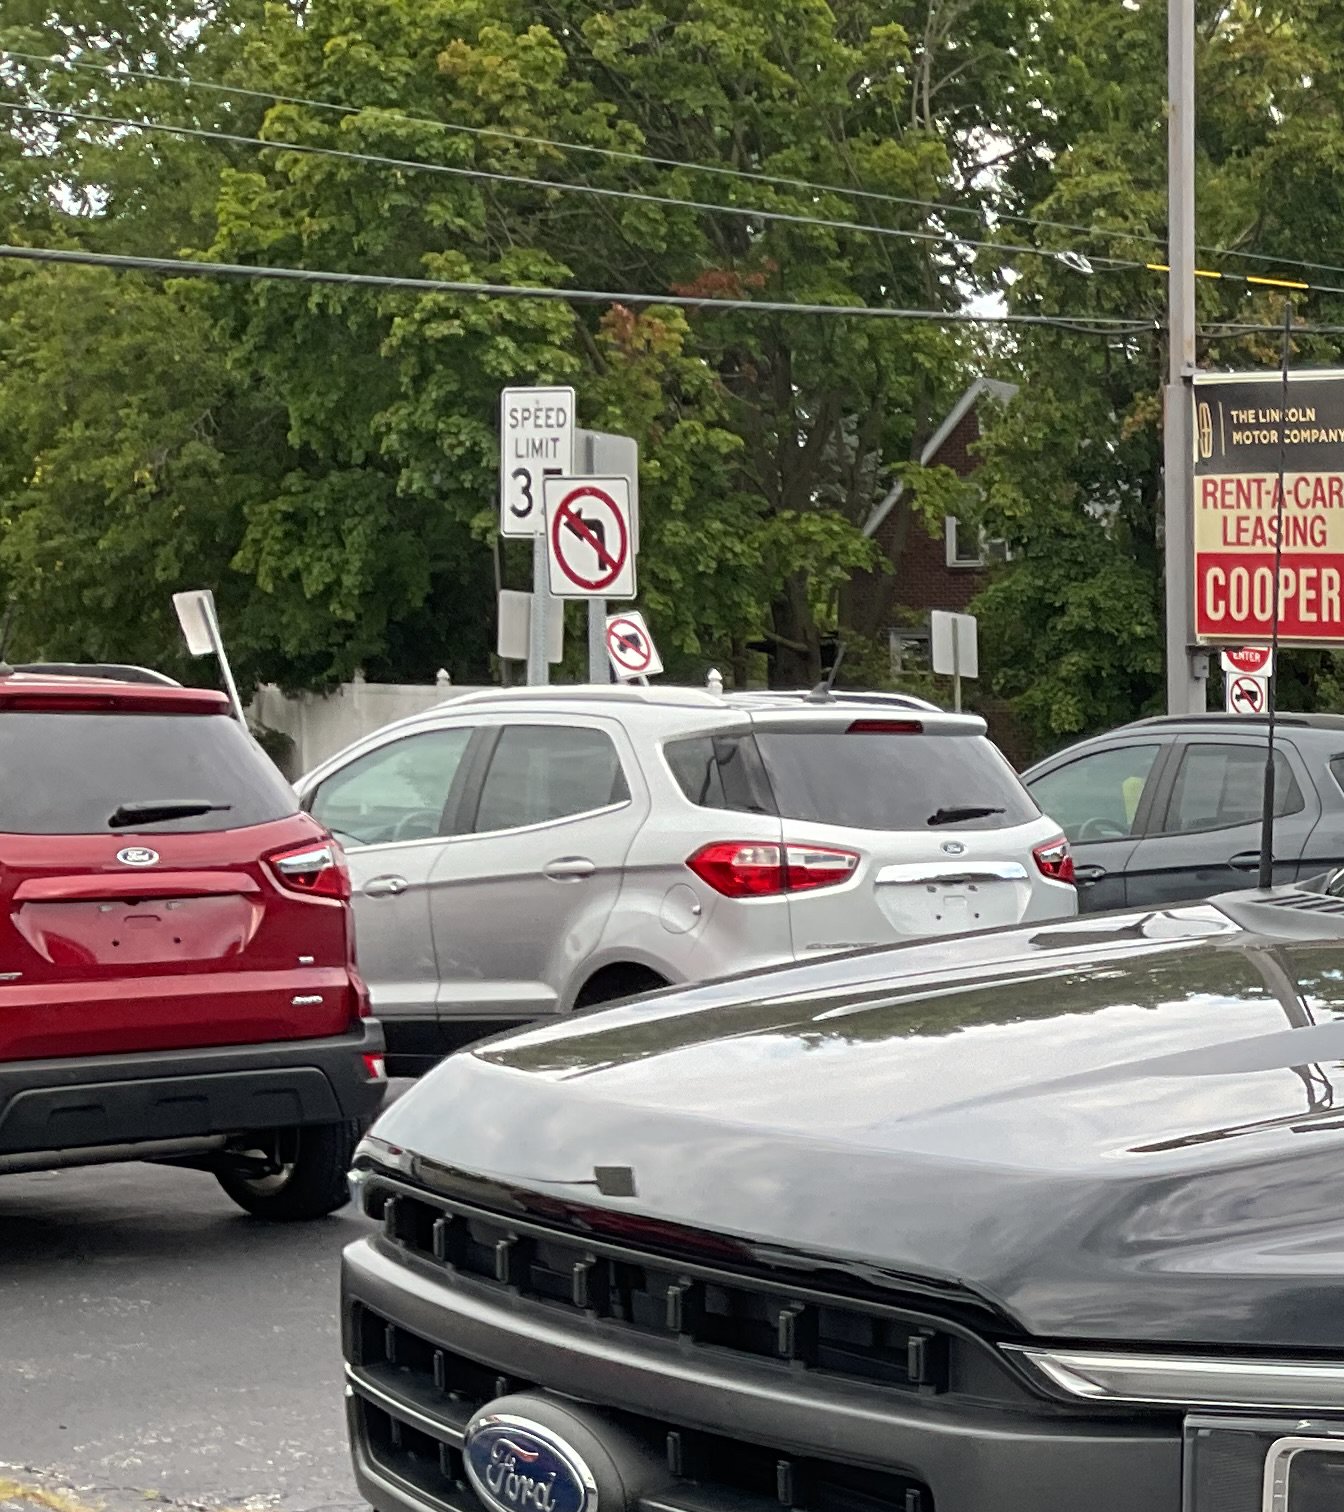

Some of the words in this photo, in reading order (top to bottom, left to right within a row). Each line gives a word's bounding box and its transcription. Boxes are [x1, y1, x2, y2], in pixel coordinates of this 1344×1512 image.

[509, 407, 567, 429] SPEED
[1230, 409, 1257, 424] THE
[514, 437, 560, 459] LIMIT
[1232, 430, 1279, 446] MOTOR
[1202, 476, 1344, 510] RENT-A-CAR
[1222, 514, 1327, 548] LEASING
[1205, 565, 1342, 624] COOPER
[1232, 650, 1261, 663] ENTER
[486, 1437, 557, 1512] Ford
